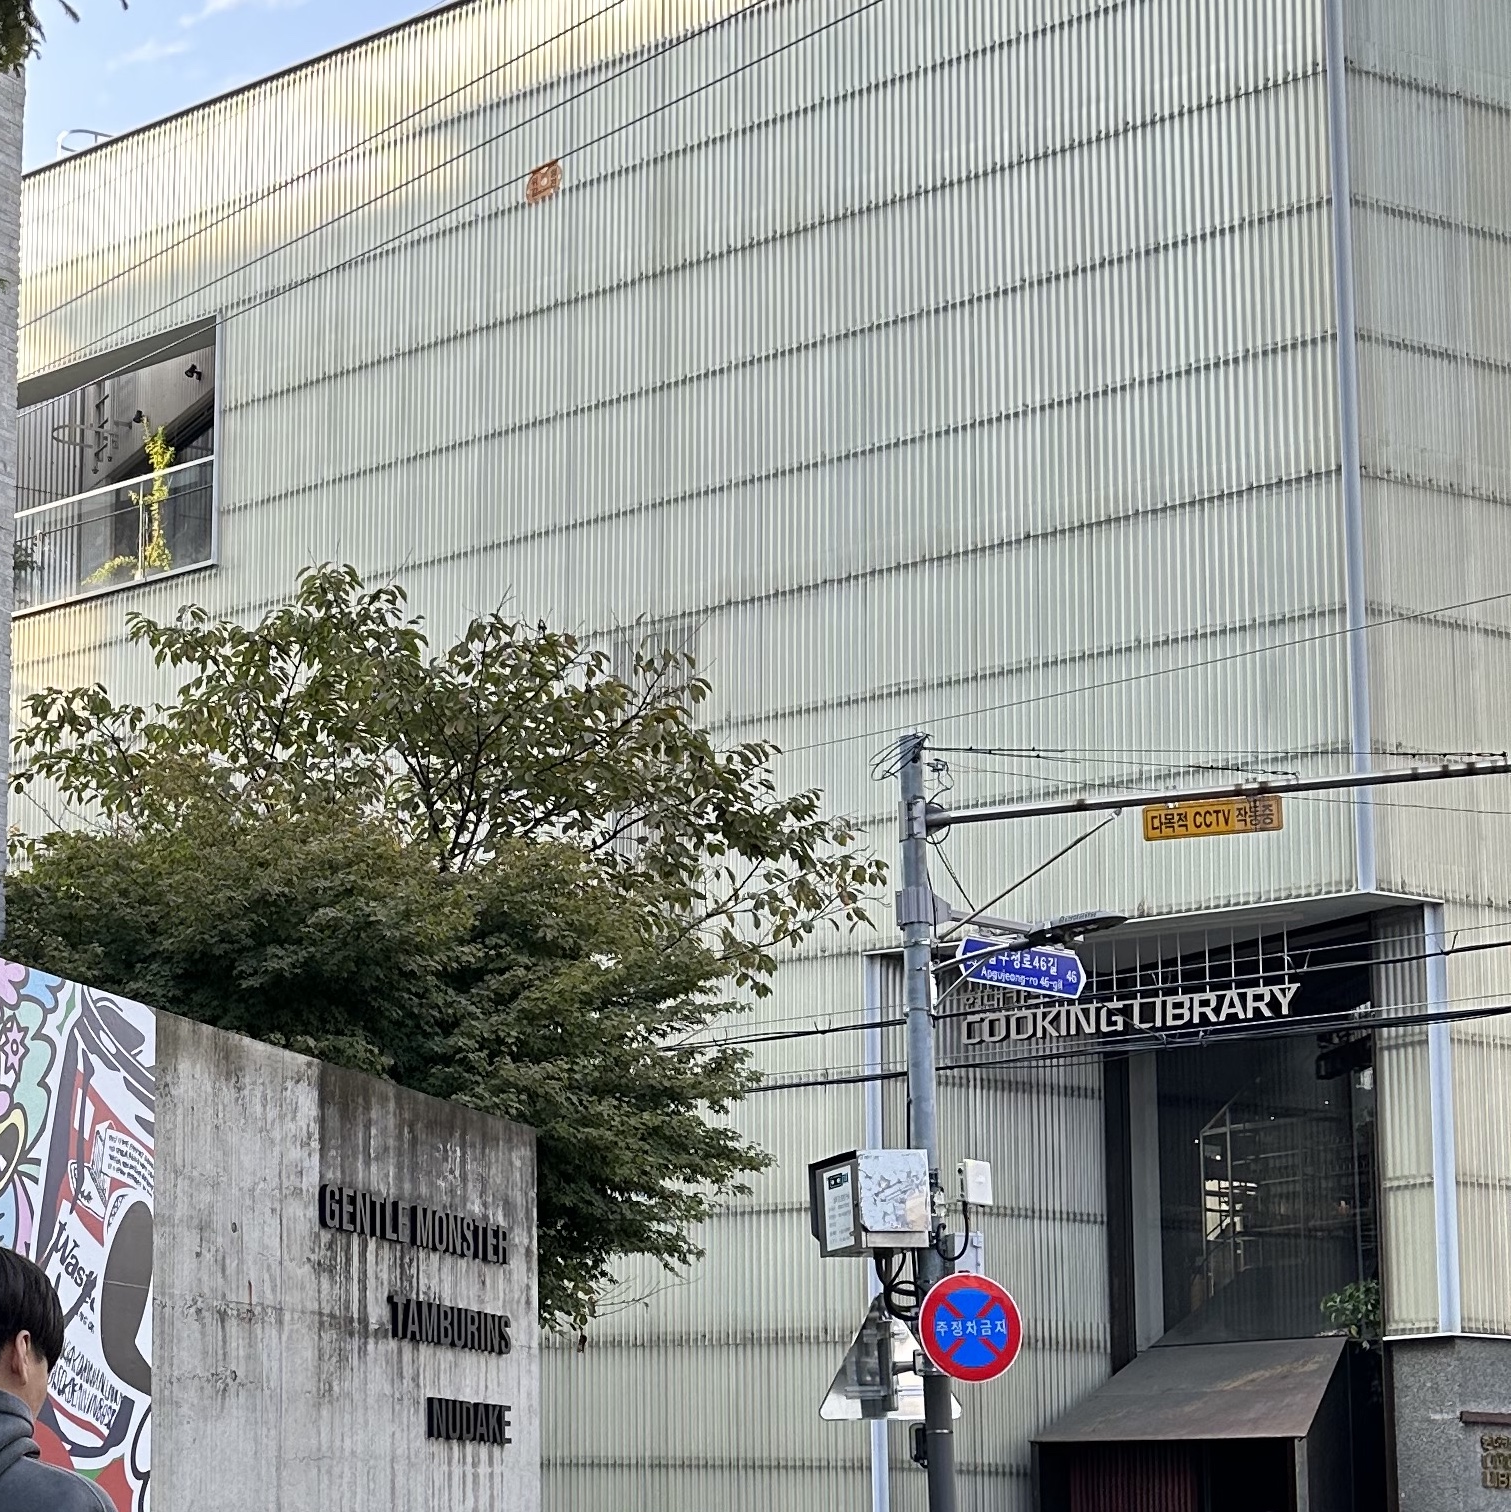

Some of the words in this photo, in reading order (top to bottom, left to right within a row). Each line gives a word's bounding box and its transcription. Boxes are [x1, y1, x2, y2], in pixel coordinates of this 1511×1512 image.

[1151, 811, 1188, 834] 다목적
[1193, 809, 1231, 829] CCTV
[1236, 804, 1274, 827] 작동중
[981, 967, 1037, 986] Apgujeong-ro
[1066, 970, 1077, 984] 46
[962, 1003, 1123, 1045] COOKING
[1133, 983, 1300, 1029] LIBRARY
[320, 1183, 410, 1244] GENTLE
[411, 1204, 509, 1265] MONSTER
[388, 1296, 511, 1354] TAMBURINS
[936, 1319, 1007, 1337] 주정차금지
[426, 1397, 511, 1444] NUDAKE
